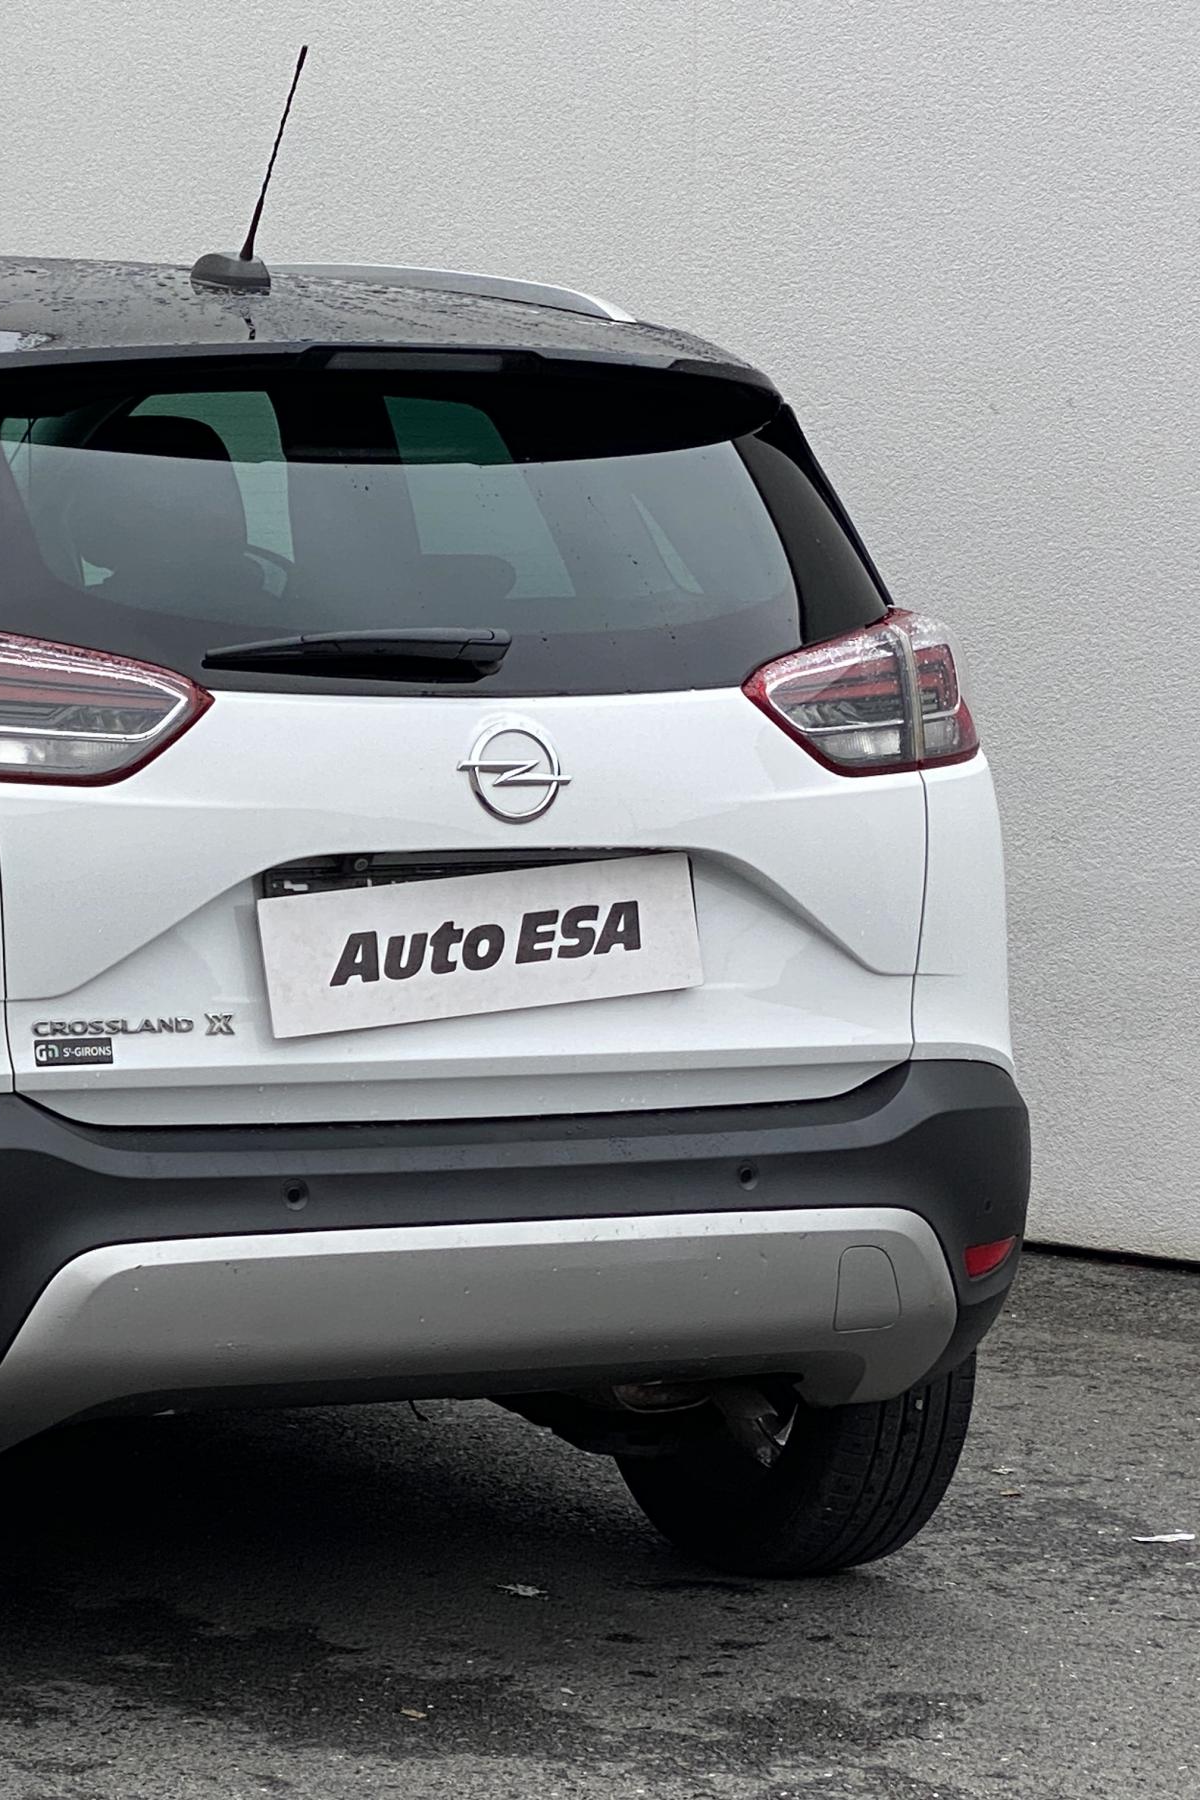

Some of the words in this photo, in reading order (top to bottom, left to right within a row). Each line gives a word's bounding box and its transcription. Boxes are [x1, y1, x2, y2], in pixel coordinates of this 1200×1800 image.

[330, 920, 505, 987] Auto
[515, 900, 641, 964] ESA
[32, 1016, 194, 1037] CROSSLAND
[205, 1012, 235, 1036] X
